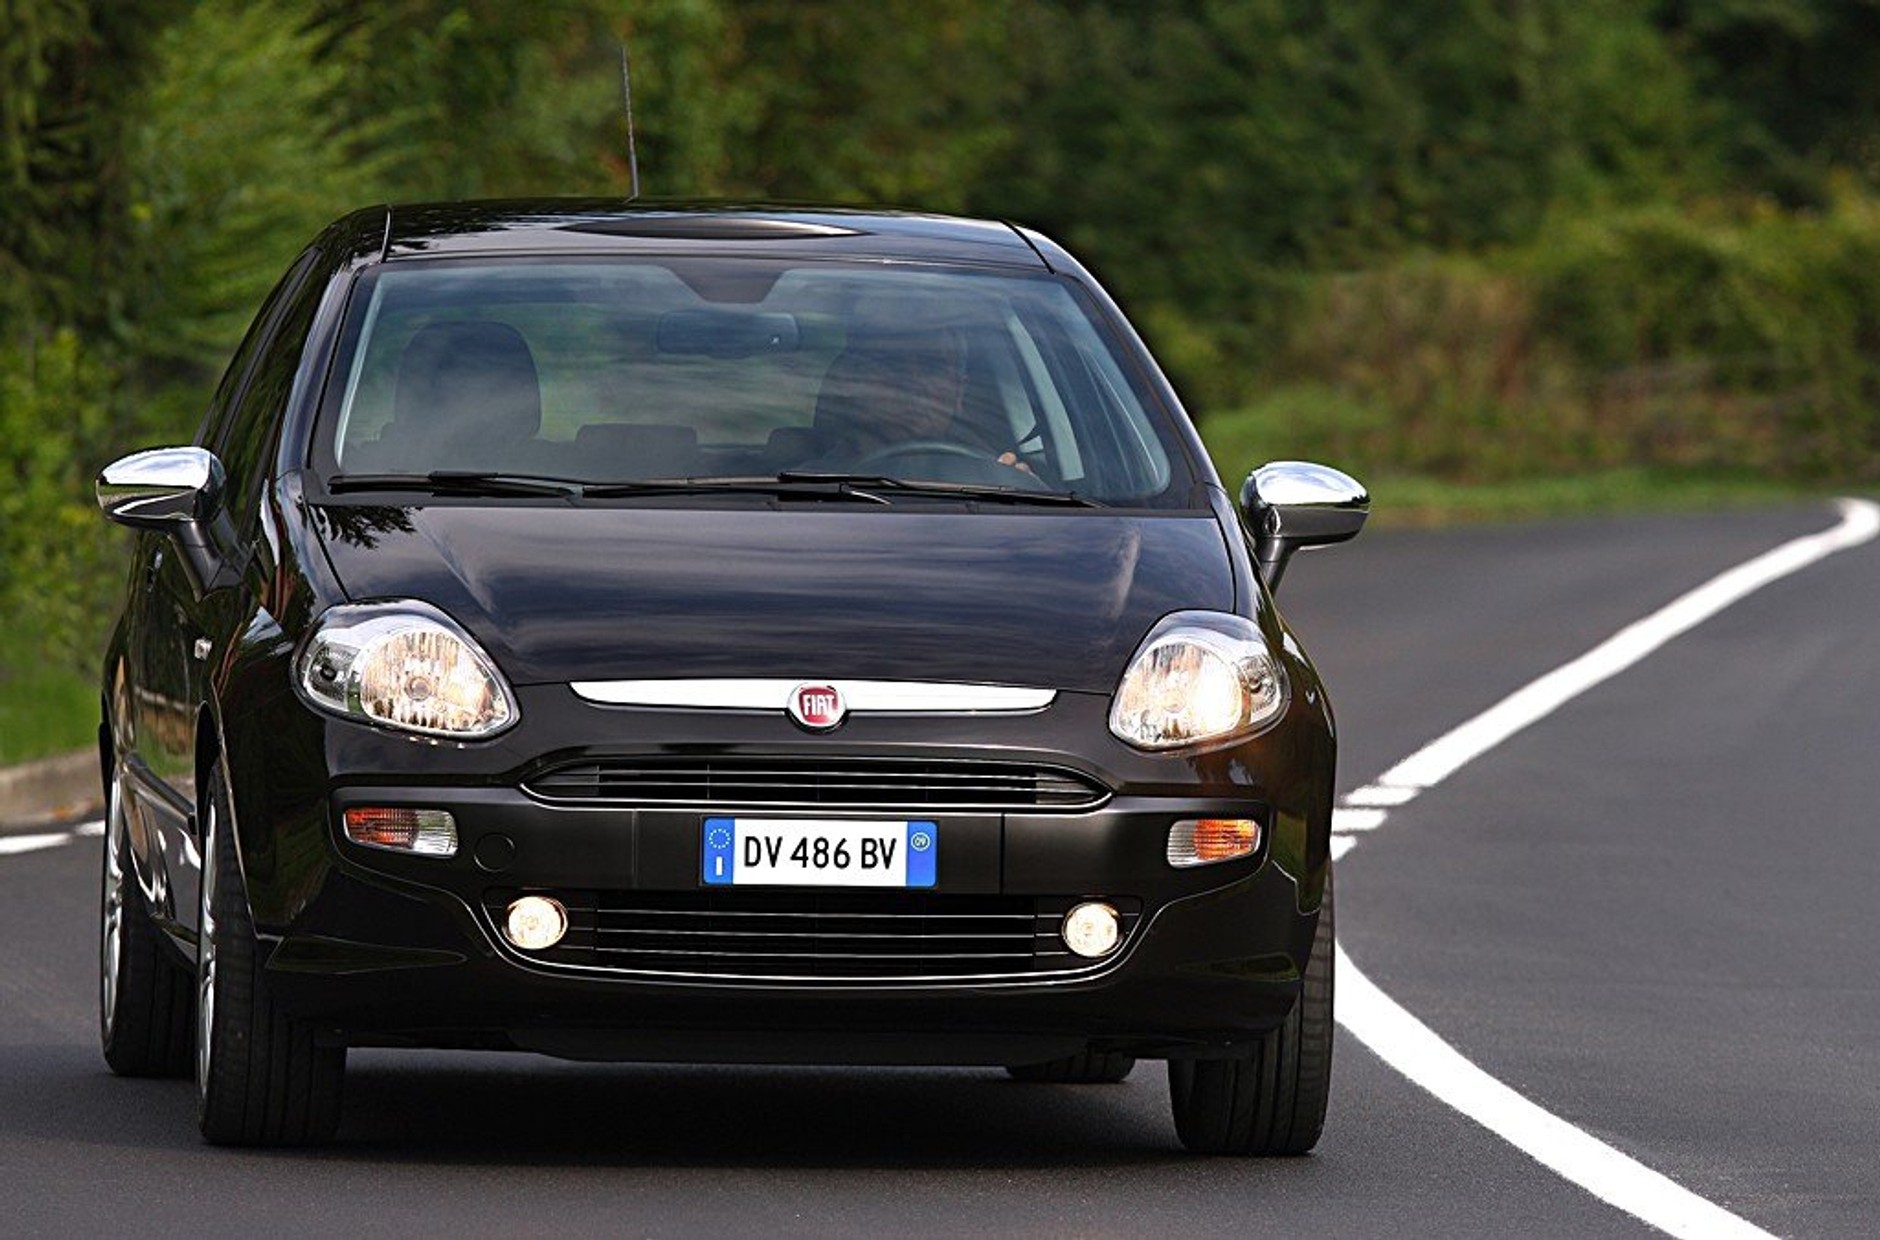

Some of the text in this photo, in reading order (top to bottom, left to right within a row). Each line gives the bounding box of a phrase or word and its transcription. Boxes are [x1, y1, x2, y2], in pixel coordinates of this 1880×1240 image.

[802, 694, 835, 716] FIAT
[744, 836, 897, 870] DV 486 BV
